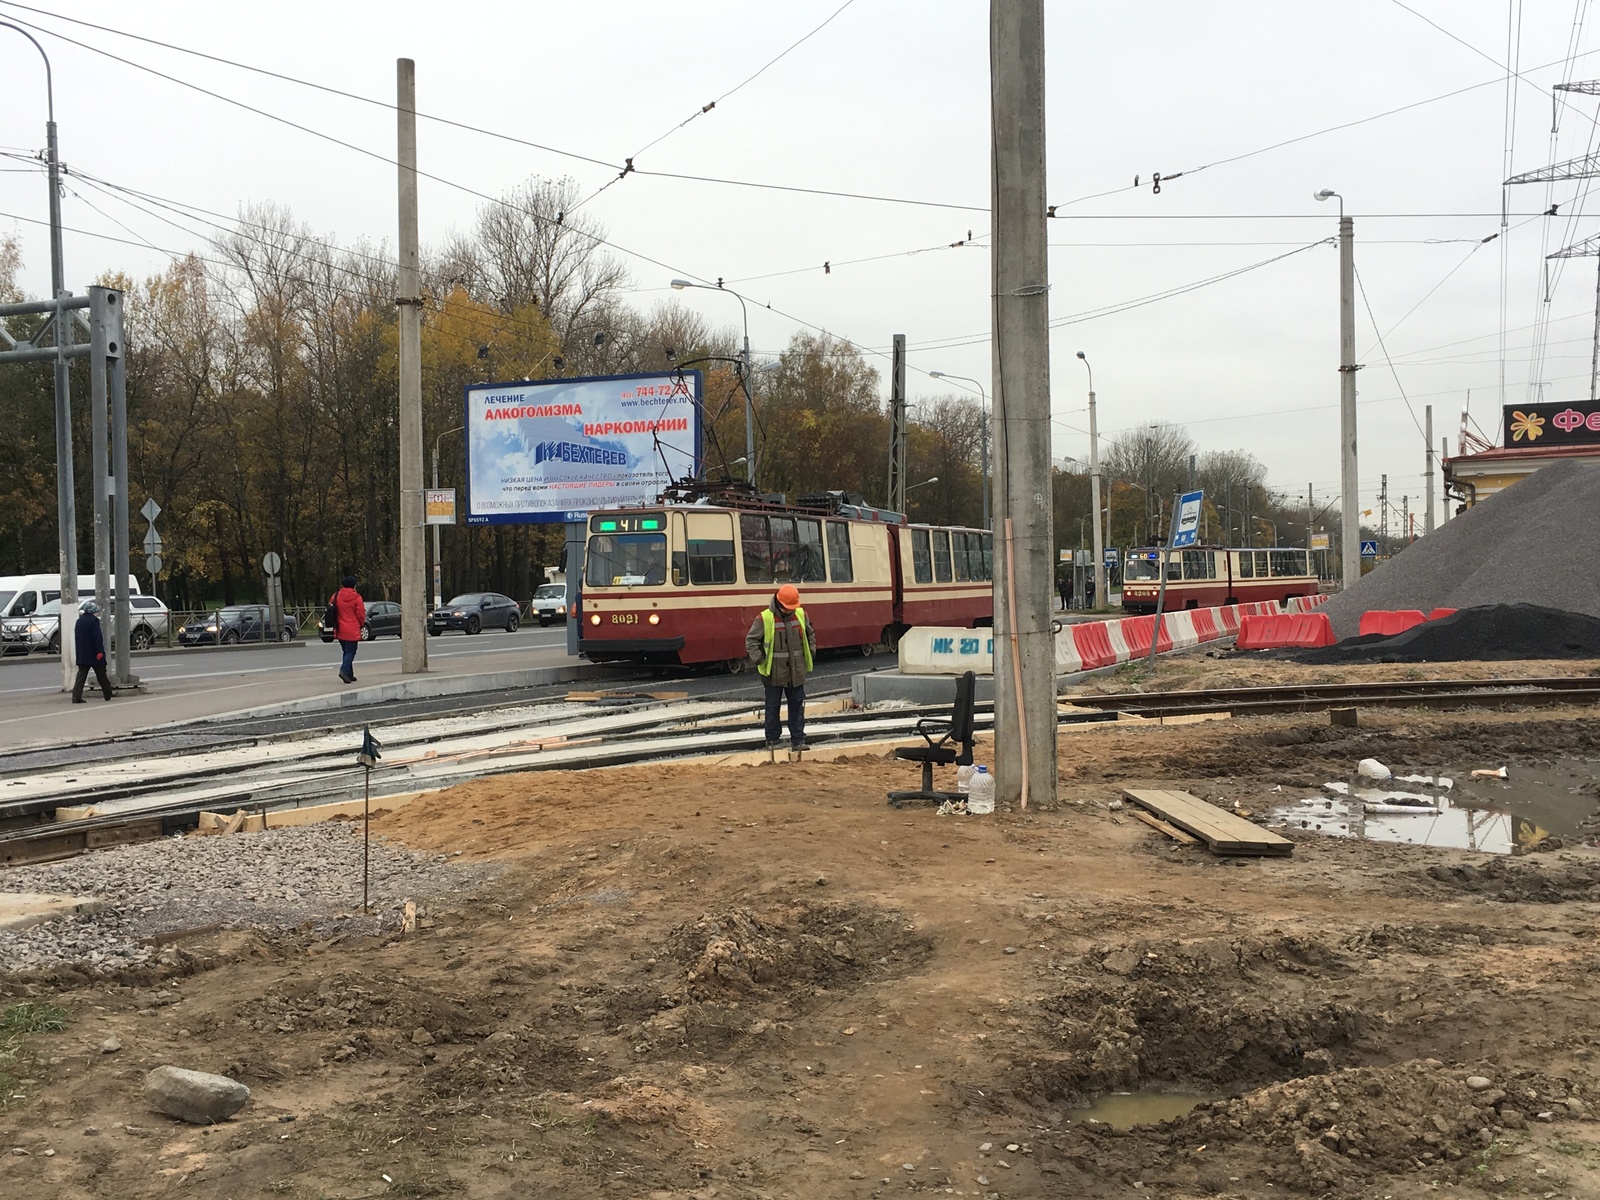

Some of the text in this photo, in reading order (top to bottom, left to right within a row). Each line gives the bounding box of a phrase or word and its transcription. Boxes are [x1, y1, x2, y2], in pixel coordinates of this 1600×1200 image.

[484, 394, 525, 404] ЛЕЧЕНИЕ
[485, 404, 582, 420] АЛКОГОЛИЗМА
[584, 418, 687, 436] НАРКОМАНИИ
[561, 441, 627, 466] БЕХТЕРЕВ
[501, 476, 525, 484] НИЗКАЯ
[526, 476, 543, 484] ЦЕНА
[513, 485, 532, 493] перед
[549, 482, 586, 490] НАСТОЯЩИЕ
[588, 480, 615, 488] ЛИДЕРЫ
[620, 519, 638, 531] 41
